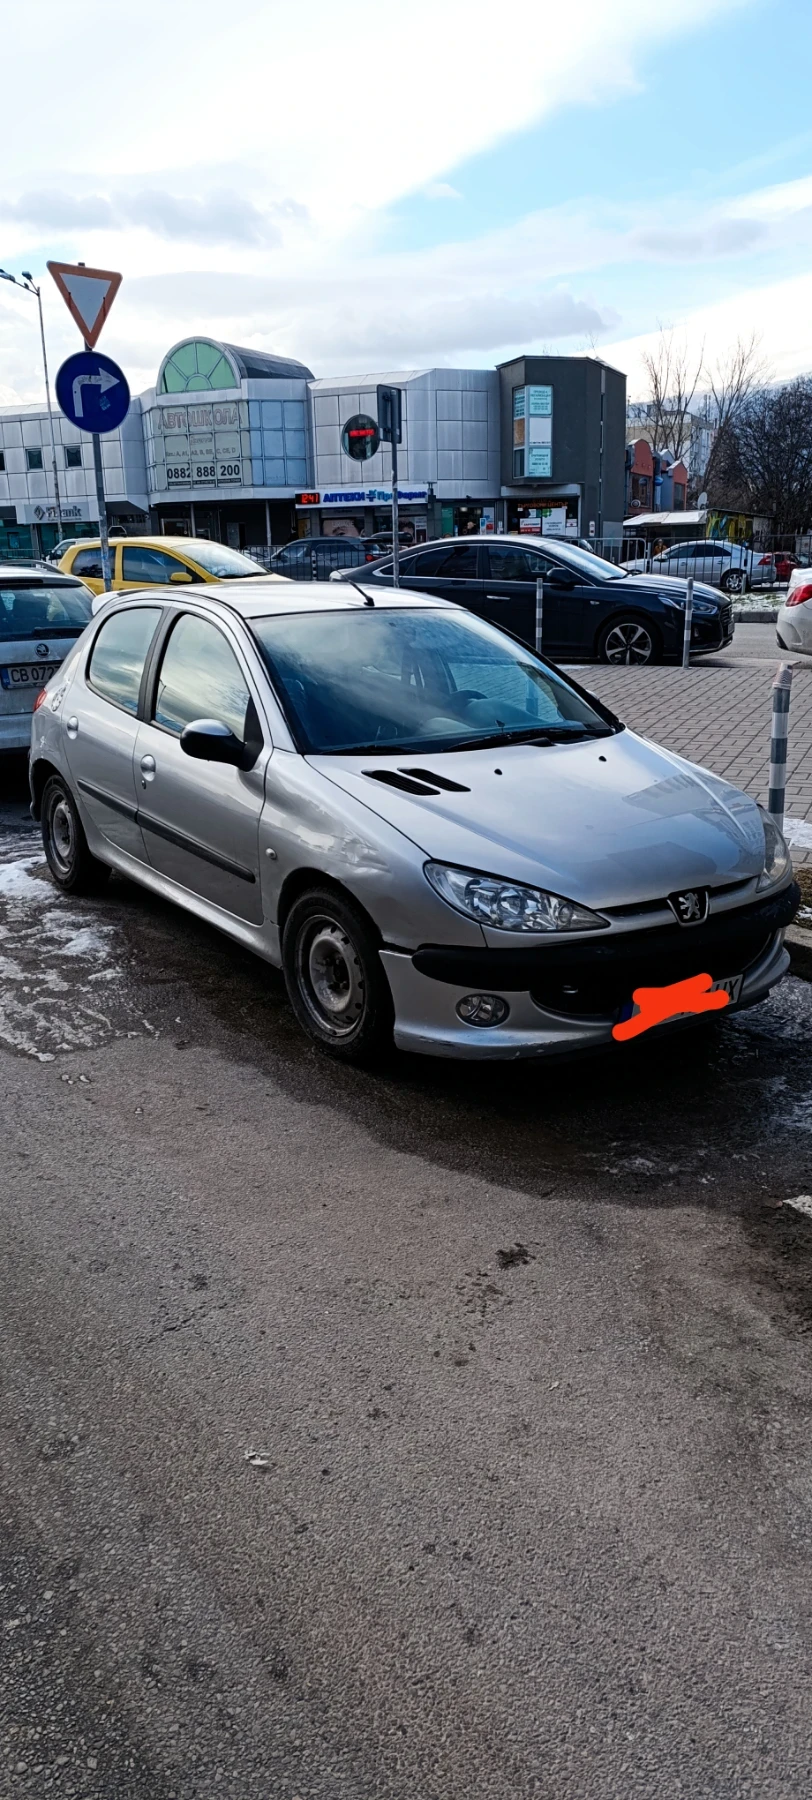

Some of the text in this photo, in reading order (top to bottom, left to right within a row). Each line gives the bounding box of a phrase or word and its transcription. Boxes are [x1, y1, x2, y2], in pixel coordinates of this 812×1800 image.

[158, 408, 242, 430] АВТОШКОЛА
[167, 464, 240, 479] 0882 888 200
[323, 492, 365, 502] АПТЕКИ
[46, 506, 82, 517] Fiank
[11, 669, 29, 682] CB
